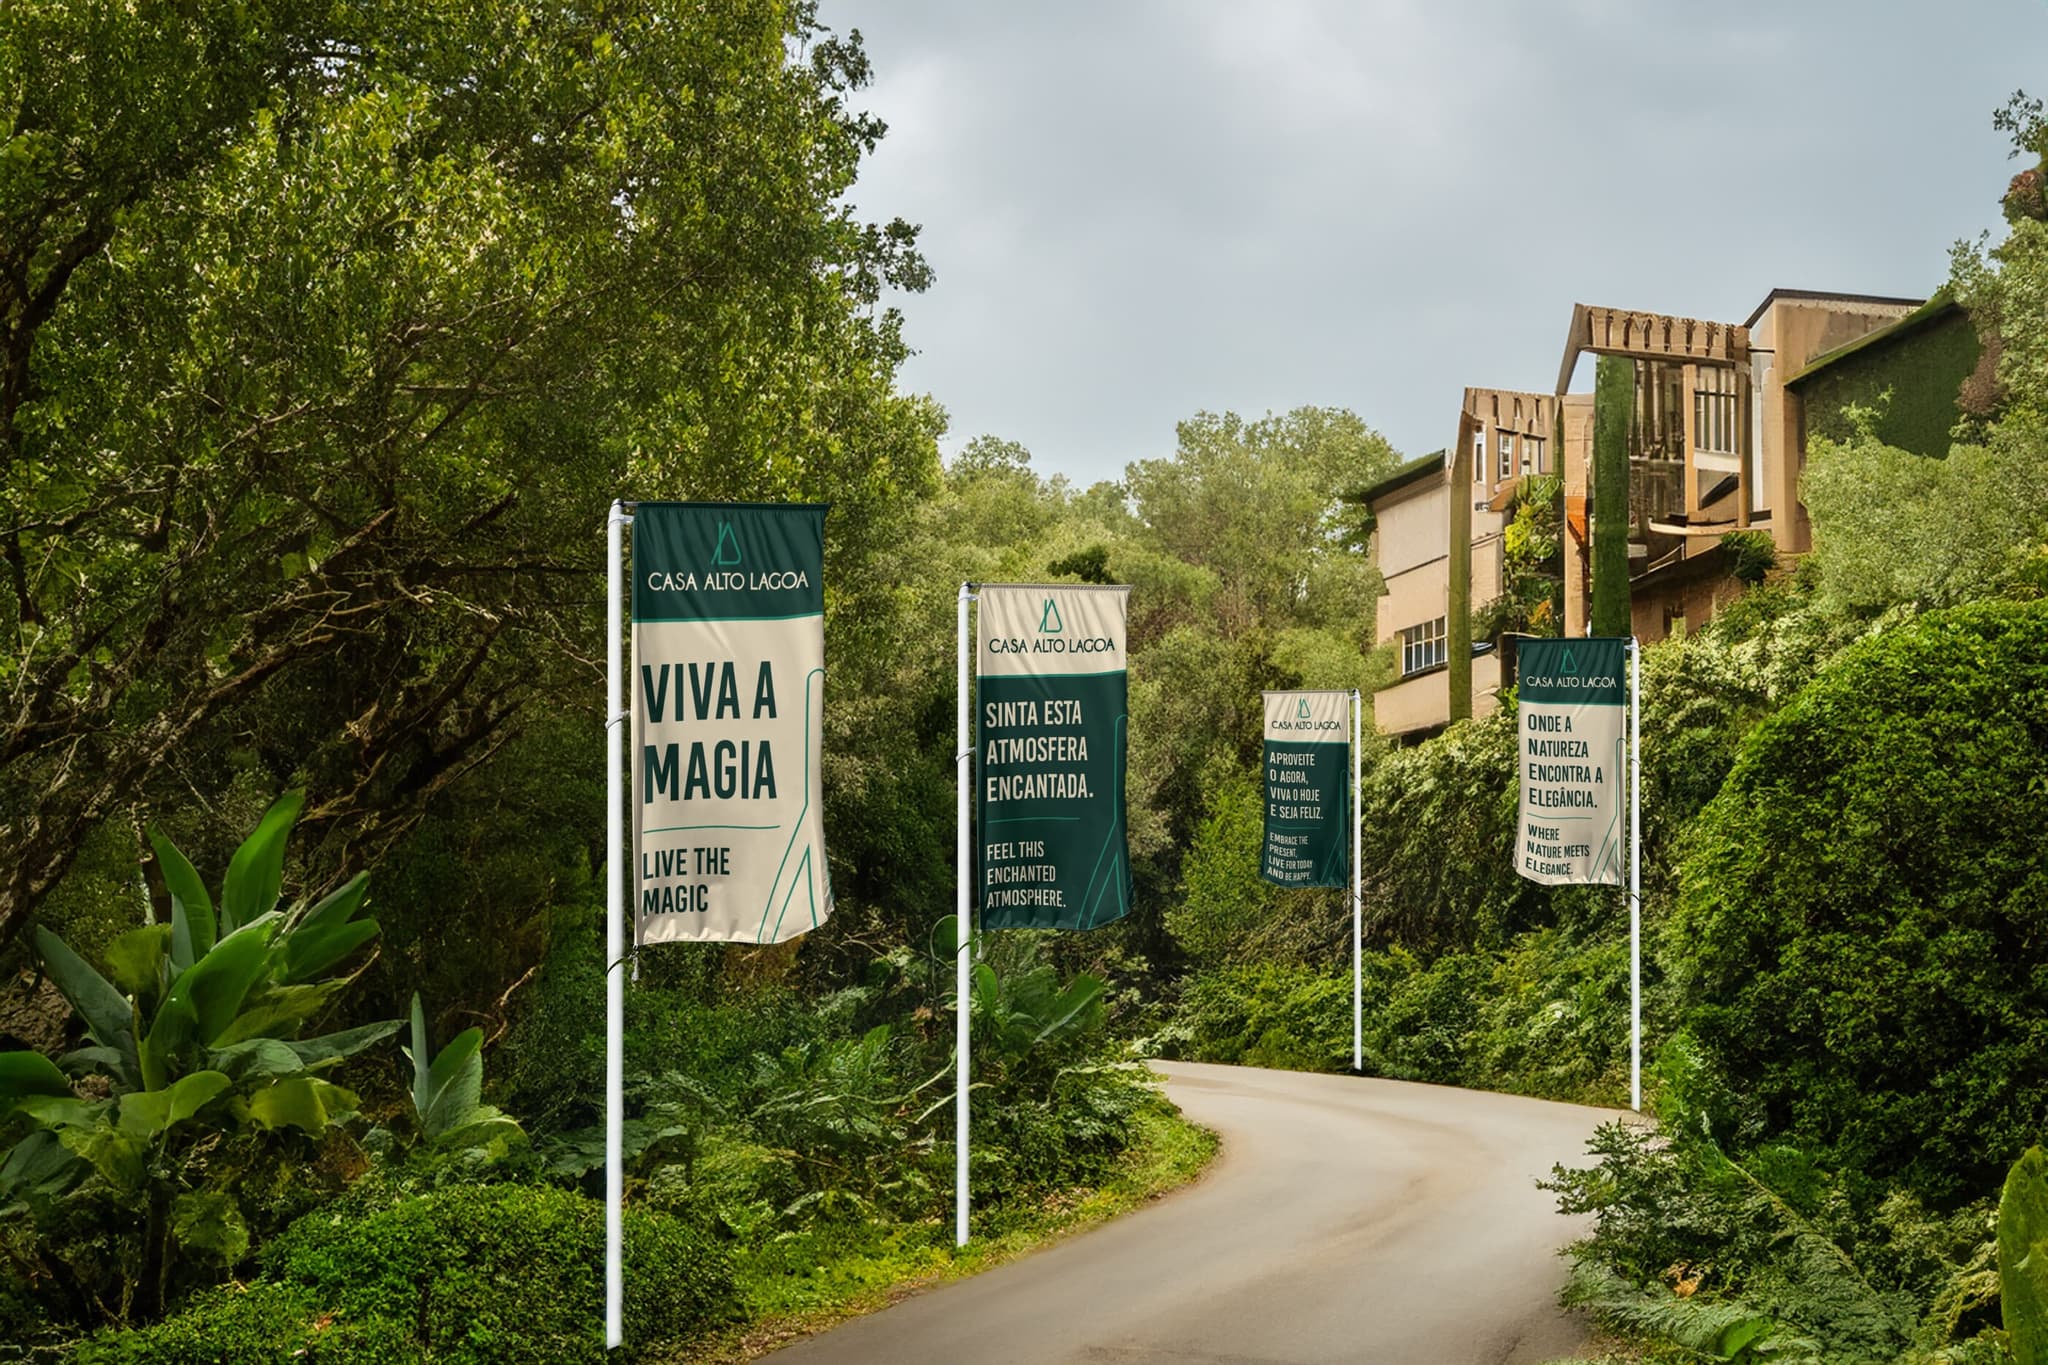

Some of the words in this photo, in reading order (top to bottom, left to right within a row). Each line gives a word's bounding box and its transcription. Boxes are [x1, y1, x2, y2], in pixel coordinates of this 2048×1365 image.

[648, 571, 697, 591] CASA
[704, 572, 745, 590] ALTO
[750, 570, 808, 590] LAGOA
[989, 638, 1028, 654] CASA
[1033, 639, 1065, 653] ALTO
[1069, 637, 1115, 653] LAGOA
[1526, 676, 1553, 687] CASA
[1557, 677, 1579, 687] ALTO
[1582, 677, 1616, 688] LAGOA
[642, 661, 740, 723] VIVA
[753, 661, 777, 719] A
[986, 701, 1038, 728] SINTA
[1045, 700, 1082, 726] ESTA
[1528, 714, 1561, 732] ONDE
[1565, 716, 1572, 732] A
[1271, 721, 1292, 730] CASA
[1295, 722, 1312, 730] ALTO
[1314, 722, 1341, 730] LAGOA
[986, 737, 1088, 765] ATMOSFERA
[1528, 738, 1588, 758] NATUREZA
[1270, 752, 1315, 766] APROVEITE
[643, 740, 777, 804] MAGIA
[1270, 769, 1276, 781] O
[1280, 771, 1308, 785] AGORA,
[1529, 763, 1591, 783] ENCONTRA
[1595, 767, 1603, 784] A
[987, 774, 1094, 802] ENCANTADA.
[1270, 787, 1292, 801] VIVA
[1293, 789, 1297, 800] O
[1300, 789, 1319, 801] HOJE
[1529, 787, 1597, 808] ELEGÂNCIA.
[1270, 804, 1276, 816] E
[1280, 806, 1298, 819] SEJA
[1300, 807, 1323, 820] FELIZ.
[1270, 832, 1298, 845] EMBRACE
[1299, 836, 1308, 844] THE
[1528, 824, 1559, 840] WHERE
[987, 842, 1016, 861] FEEL
[1018, 841, 1045, 858] THIS
[1527, 841, 1562, 858] NATURE
[1564, 844, 1590, 857] MEETS
[643, 848, 688, 880] LIVE
[694, 847, 730, 876] THE
[1269, 855, 1284, 868] LIVE
[1286, 858, 1296, 869] FOR
[1297, 859, 1313, 868] TODAY
[1526, 857, 1573, 876] ELEGANCE.
[987, 865, 1056, 885] ENCHANTED
[1267, 867, 1284, 879] AND
[1285, 871, 1292, 881] BE
[643, 884, 709, 916] MAGIC
[986, 889, 1066, 909] ATMOSPHERE.
